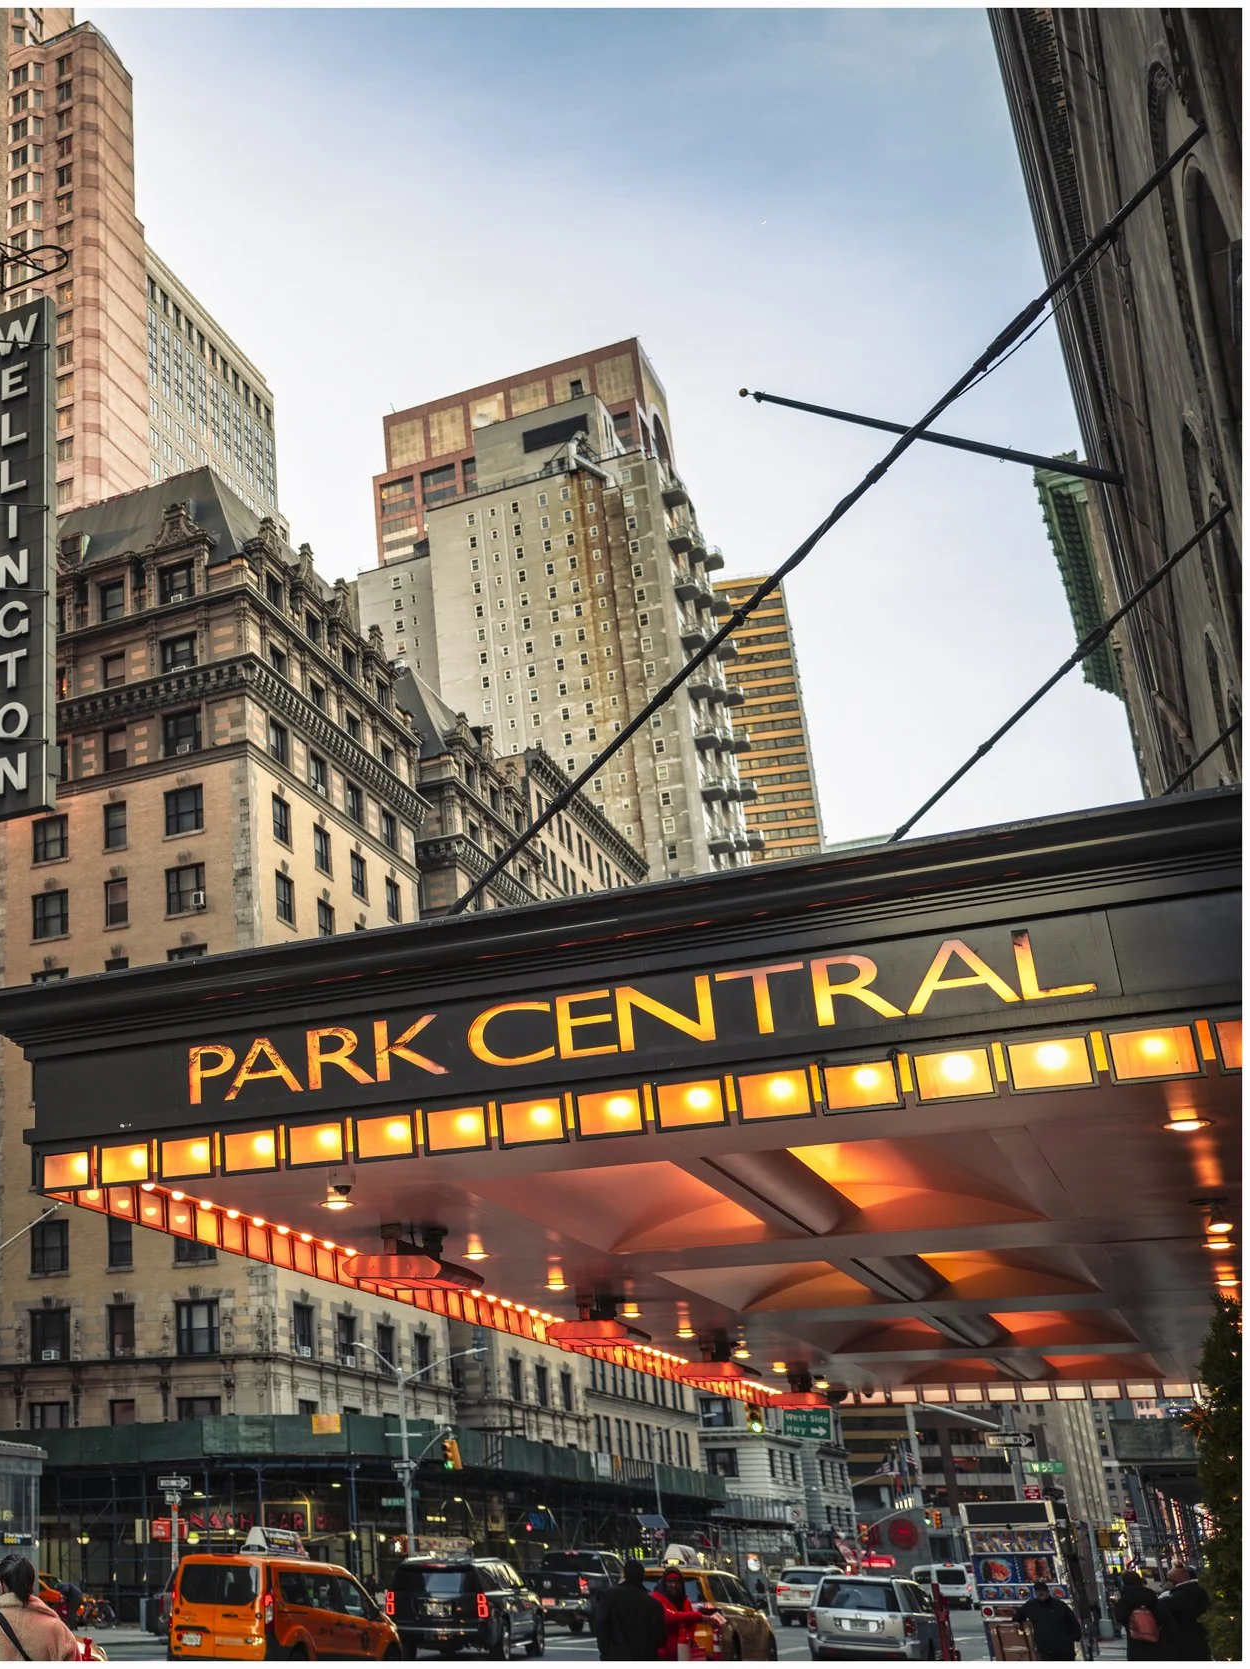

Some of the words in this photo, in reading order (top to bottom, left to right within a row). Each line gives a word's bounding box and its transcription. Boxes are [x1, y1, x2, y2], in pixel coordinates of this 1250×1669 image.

[187, 1013, 449, 1105] PARK
[467, 929, 1098, 1067] CENTRAL
[785, 1413, 807, 1422] West
[810, 1415, 829, 1424] Side
[786, 1425, 807, 1435] Hwy
[1012, 1436, 1028, 1444] WAY
[1031, 1463, 1040, 1473] W
[1041, 1463, 1054, 1473] 55
